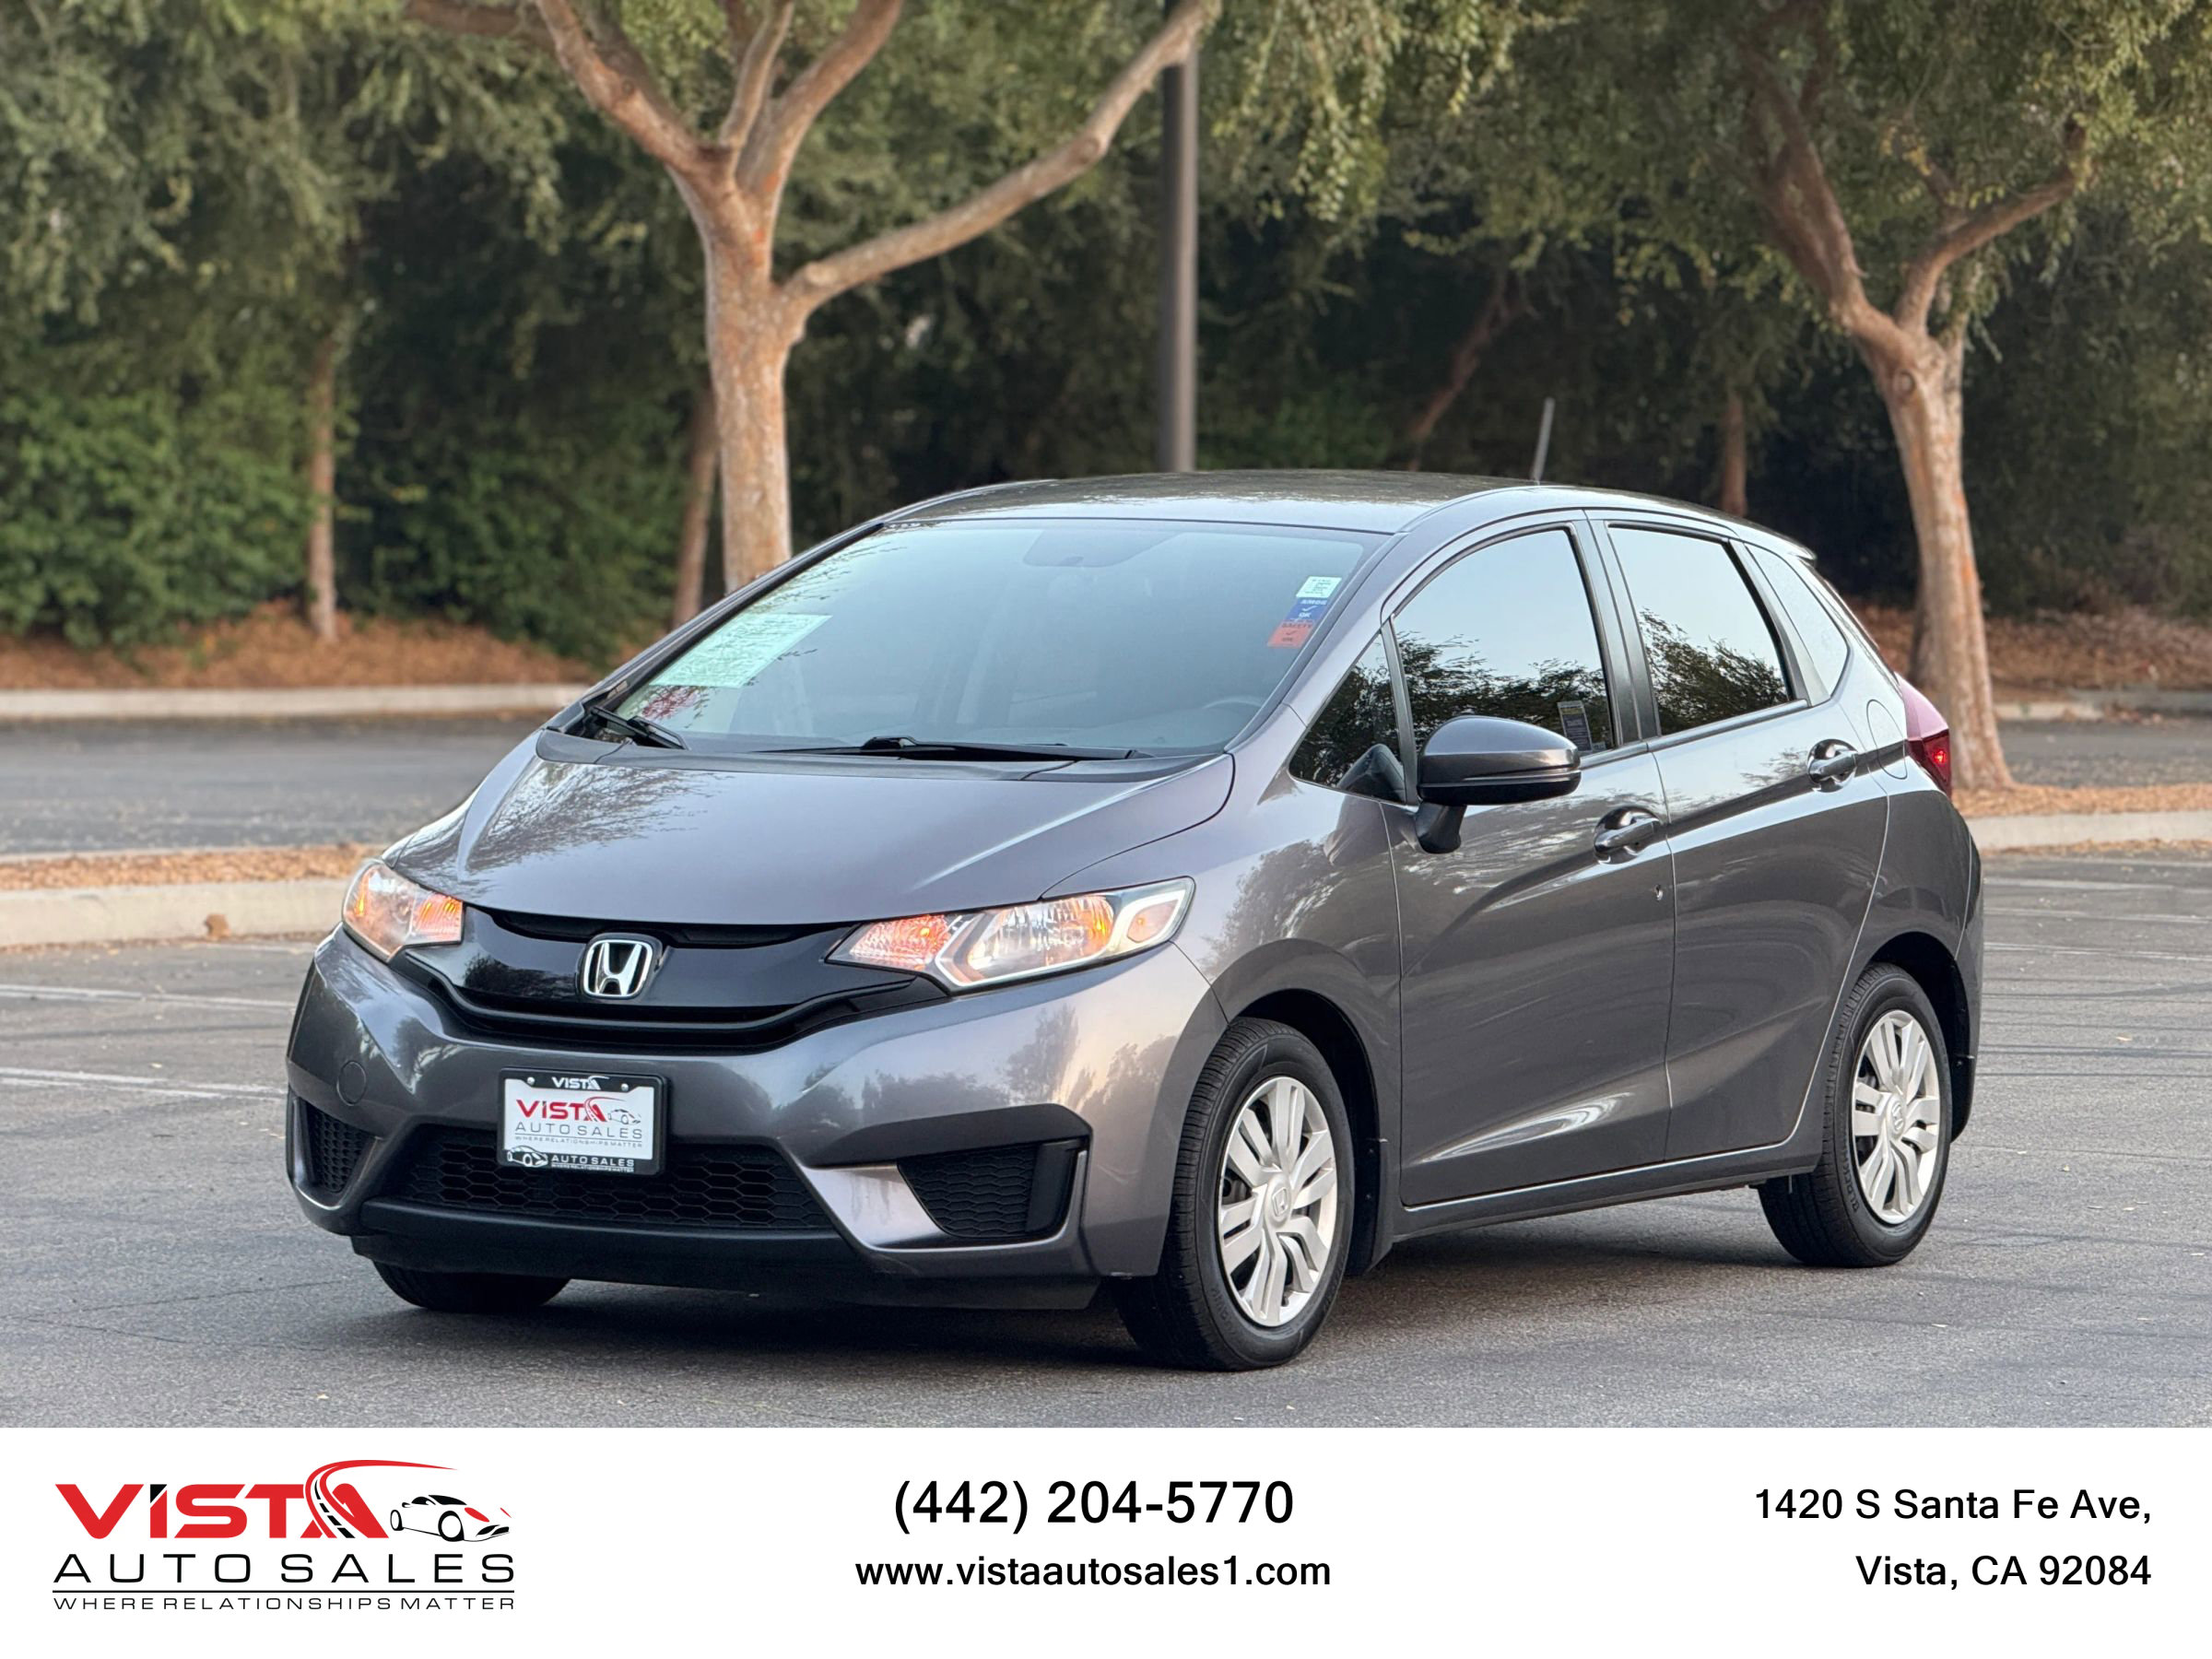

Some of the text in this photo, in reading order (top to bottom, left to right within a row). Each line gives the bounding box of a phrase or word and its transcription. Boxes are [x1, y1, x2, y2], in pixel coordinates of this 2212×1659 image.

[551, 1077, 602, 1089] VISTA
[516, 1098, 608, 1122] VISTA
[514, 1122, 642, 1139] AUTO SALES
[551, 1154, 635, 1167] AUTO SALES
